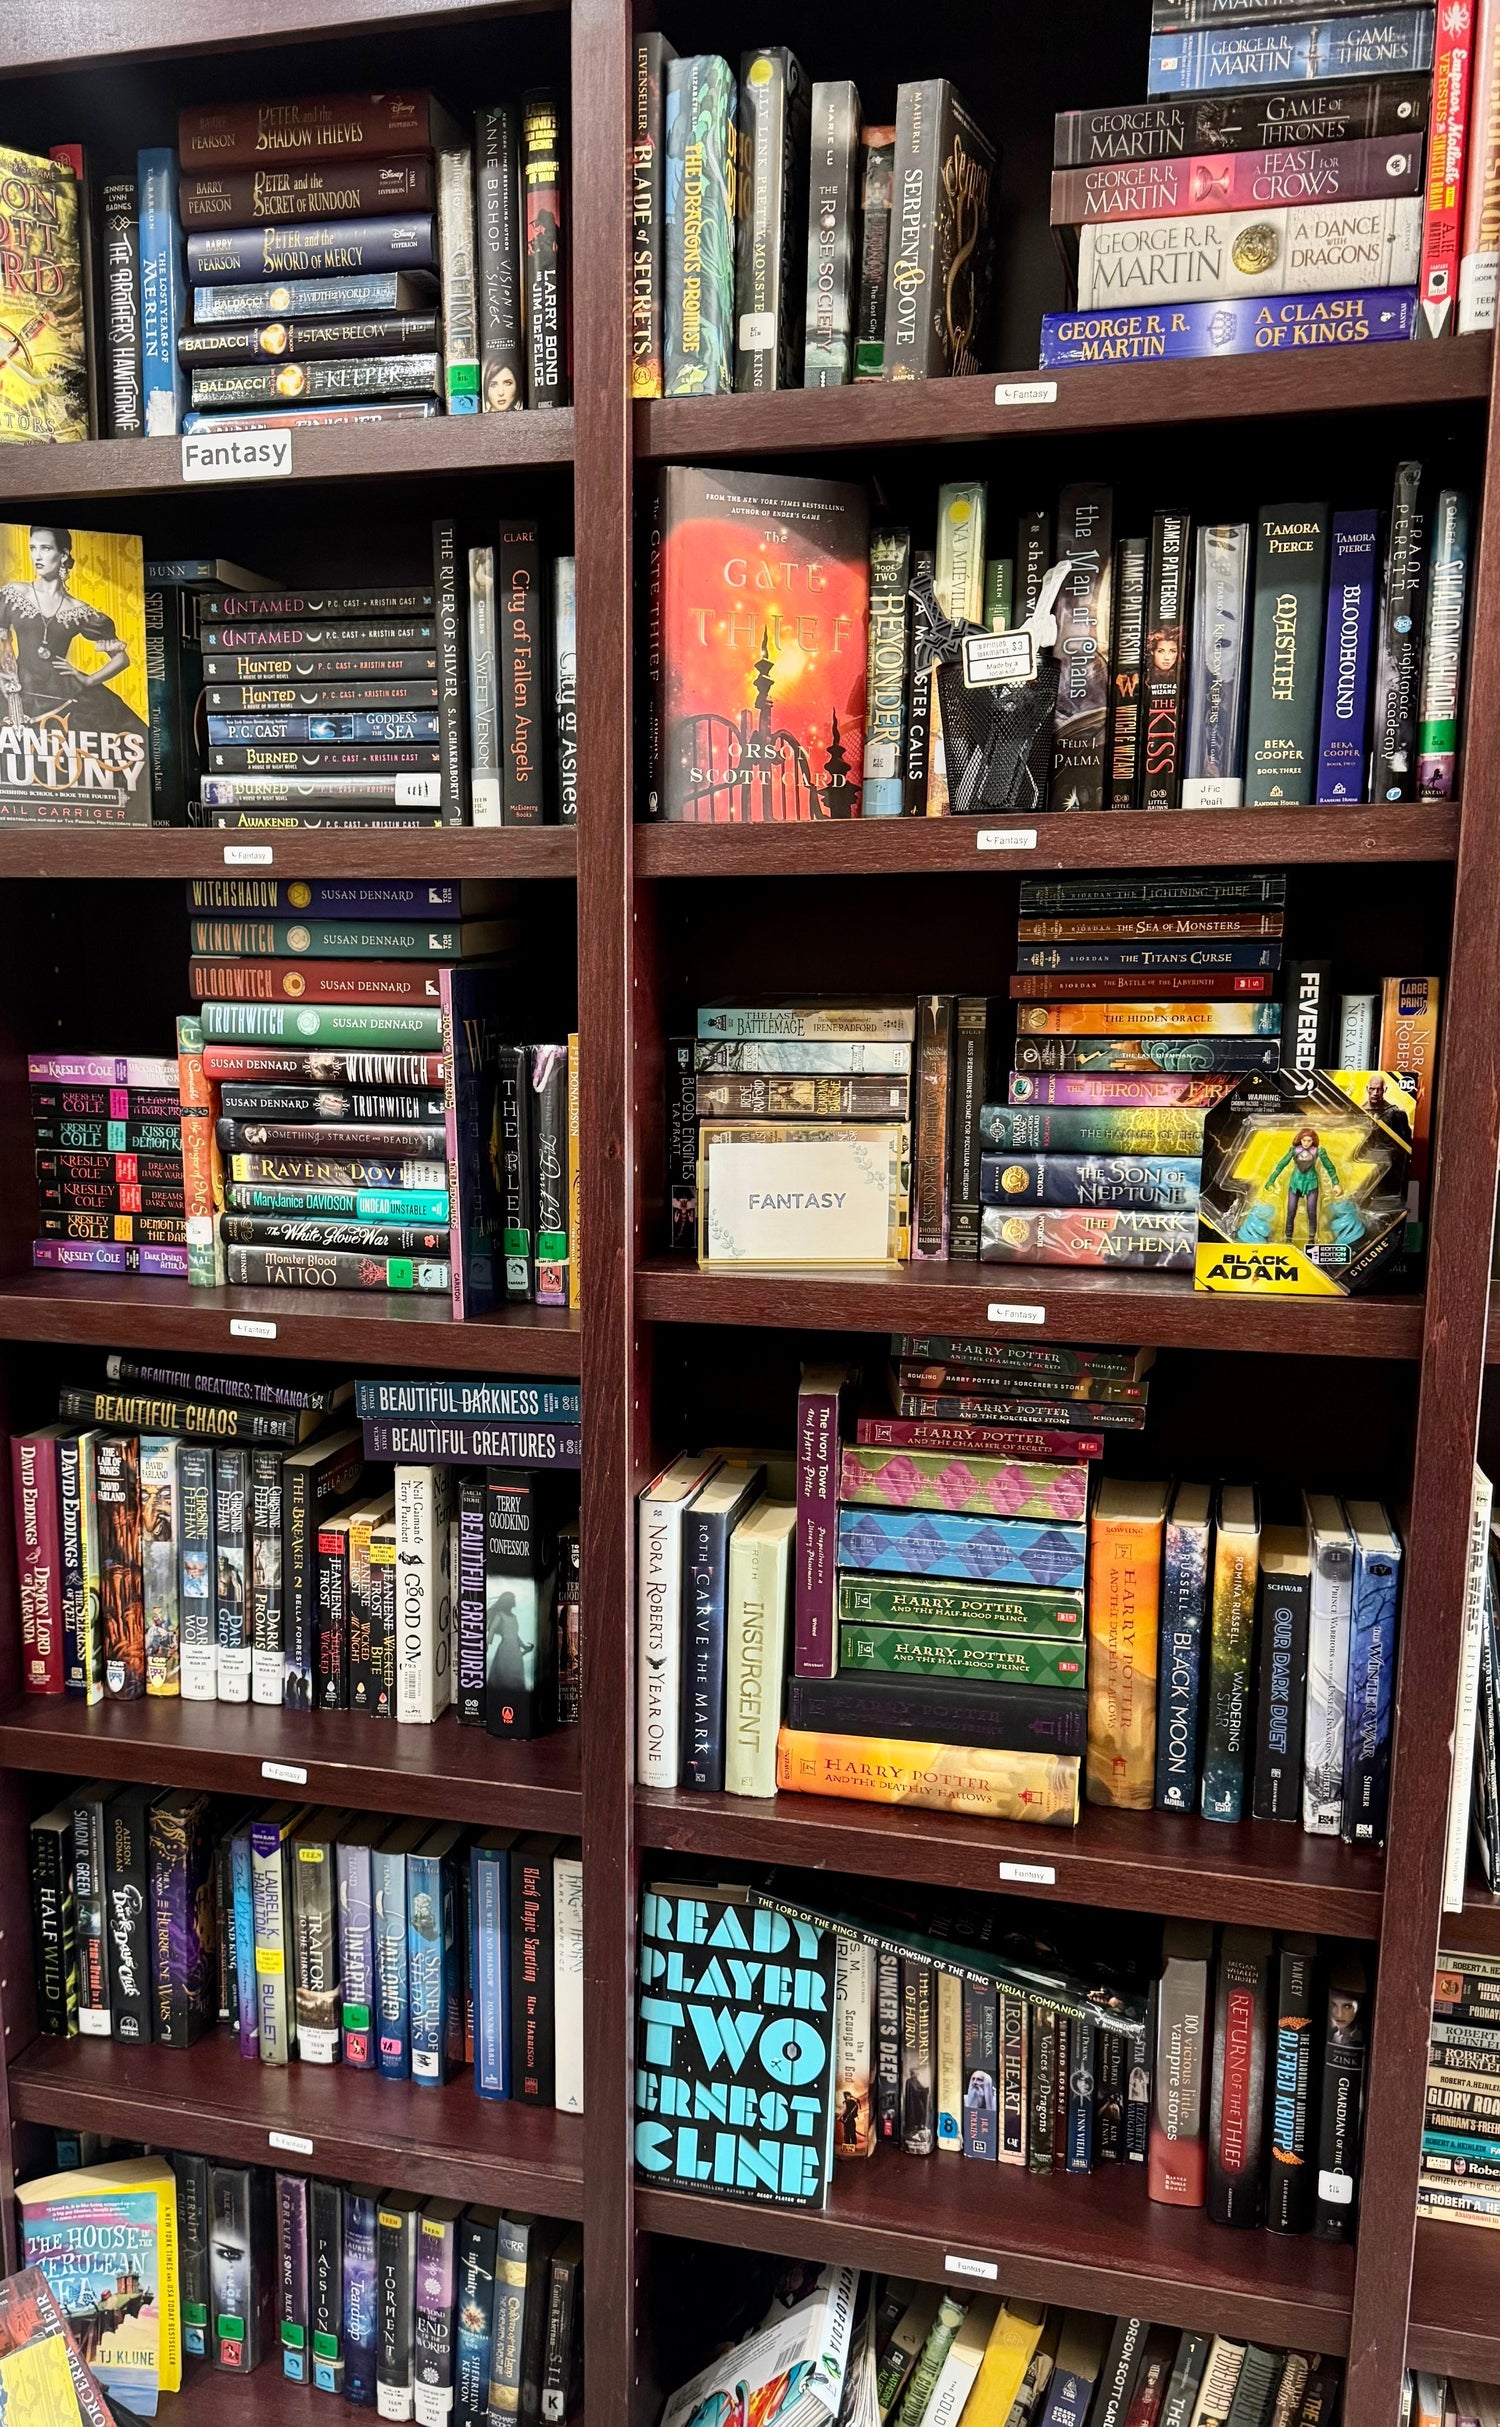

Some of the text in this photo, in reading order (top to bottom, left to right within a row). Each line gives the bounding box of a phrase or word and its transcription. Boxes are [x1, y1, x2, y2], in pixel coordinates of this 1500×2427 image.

[827, 104, 835, 166] MARIE LU
[911, 92, 922, 154] MAHURIN
[485, 114, 500, 252] ANNE BISHOP
[634, 144, 651, 225] BLADE
[1095, 233, 1179, 255] GEORGE
[1294, 217, 1380, 241] A DANCE
[263, 247, 363, 273] SWORD OF MERCY
[1092, 249, 1223, 289] MARTIN
[1291, 244, 1380, 268] DRAGONS
[143, 259, 159, 357] MERLIN
[633, 251, 652, 355] SECRETS
[1256, 300, 1364, 325] A CLASH
[109, 233, 140, 432] THE BROTHERS HAWTHORNE
[303, 327, 340, 343] STARS
[342, 324, 388, 339] BELOW
[543, 270, 558, 386] LARRY BOND
[1255, 321, 1369, 347] OF KINGS
[185, 337, 249, 351] BALDACCI
[186, 442, 287, 467] Fantasy
[731, 508, 759, 516] AUTHOR
[773, 510, 799, 519] ENDER'S
[1264, 522, 1320, 536] TAMORA
[1269, 540, 1313, 553] PIERCE
[724, 559, 827, 594] GATE
[1160, 517, 1180, 619] JAMES PATTERSON
[440, 529, 457, 701] THE RIVER OF SILVER
[222, 630, 303, 647] UNTAMED
[689, 609, 853, 653] THIEF
[1336, 585, 1360, 719] BLOODHOUND
[508, 568, 533, 782] City of Fallen Angels
[728, 744, 812, 759] ORSON
[1146, 708, 1176, 774] KISS
[690, 768, 846, 788] SCOTT CARD
[38, 806, 126, 820] CARRIGER
[994, 835, 1028, 846] Fantasy
[193, 881, 278, 907] WITCHSHADOW
[321, 890, 414, 901] SUSAN DENNARD
[197, 924, 274, 953] WINDWITCH
[1117, 921, 1241, 934] THE SEA OF MONSTERS
[195, 968, 272, 998] BLOODWITCH
[1401, 983, 1427, 995] LARGE
[1401, 997, 1425, 1008] PRINT
[208, 1006, 283, 1035] TRUTHWITCH
[737, 1017, 805, 1037] BATTLEMAGE
[1105, 1015, 1212, 1023] THE HIDDEN ORACLE
[1296, 973, 1320, 1071] FEVERED
[48, 1063, 113, 1076] KRESLEY COLE
[1080, 1160, 1186, 1184] THE SON OF
[254, 1192, 353, 1212] MaryJanice DAVIDSON
[749, 1193, 846, 1210] FANTASY
[1080, 1184, 1185, 1203] NEPTUNE
[265, 1253, 337, 1266] Monster Blood
[1206, 1265, 1298, 1281] ADAM
[1222, 1255, 1289, 1266] BLACK
[1351, 1239, 1389, 1277] CYCLONE
[266, 1267, 337, 1286] TATTOO
[95, 1395, 238, 1435] BEAUTIFUL CHAOS
[379, 1387, 539, 1414] BEAUTIFUL DARKNESS
[817, 1408, 829, 1499] The Ivory Tower
[20, 1446, 39, 1545] DAVID EDDINGS
[496, 1496, 521, 1512] TERRY
[489, 1513, 530, 1531] GOODKIND
[489, 1538, 530, 1556] CONFESSOR
[647, 1524, 669, 1650] NORA ROBERTS
[295, 1627, 303, 1667] FORREST
[896, 1644, 1025, 1664] HARRY POTTER
[739, 1601, 765, 1753] INSURGENT
[1268, 1607, 1292, 1754] OUR DARK DUET
[1168, 1632, 1192, 1773] BLACK MOON
[76, 1863, 90, 1896] GREEN
[41, 1888, 56, 1939] HALF
[642, 1894, 828, 1960] READY
[862, 1934, 989, 1985] THE FELLOWSHIP OF THE RING
[642, 1946, 828, 2012] PLAYER
[262, 1983, 278, 2044] BULLET
[995, 1981, 1085, 2019] VISUAL COMPANION
[527, 2020, 536, 2067] HARRISON
[641, 1996, 827, 2086] TWO
[1005, 2000, 1021, 2115] IRON HEART
[1179, 2014, 1199, 2118] 100 vicious little
[1167, 2023, 1183, 2140] vampire stories
[1225, 1994, 1249, 2167] RETURN OF THE THIEF
[637, 2069, 822, 2137] ERNEST
[1428, 2089, 1469, 2110] GLORY
[635, 2120, 820, 2196] CLINE
[28, 2224, 139, 2253] THE HOUSE
[958, 2262, 985, 2275] Fantasy
[318, 2240, 330, 2331] PASSION
[385, 2266, 396, 2356] TORMENT
[100, 2350, 154, 2365] TJ KLUNE
[1115, 2318, 1141, 2398] ORSON SCOTT
